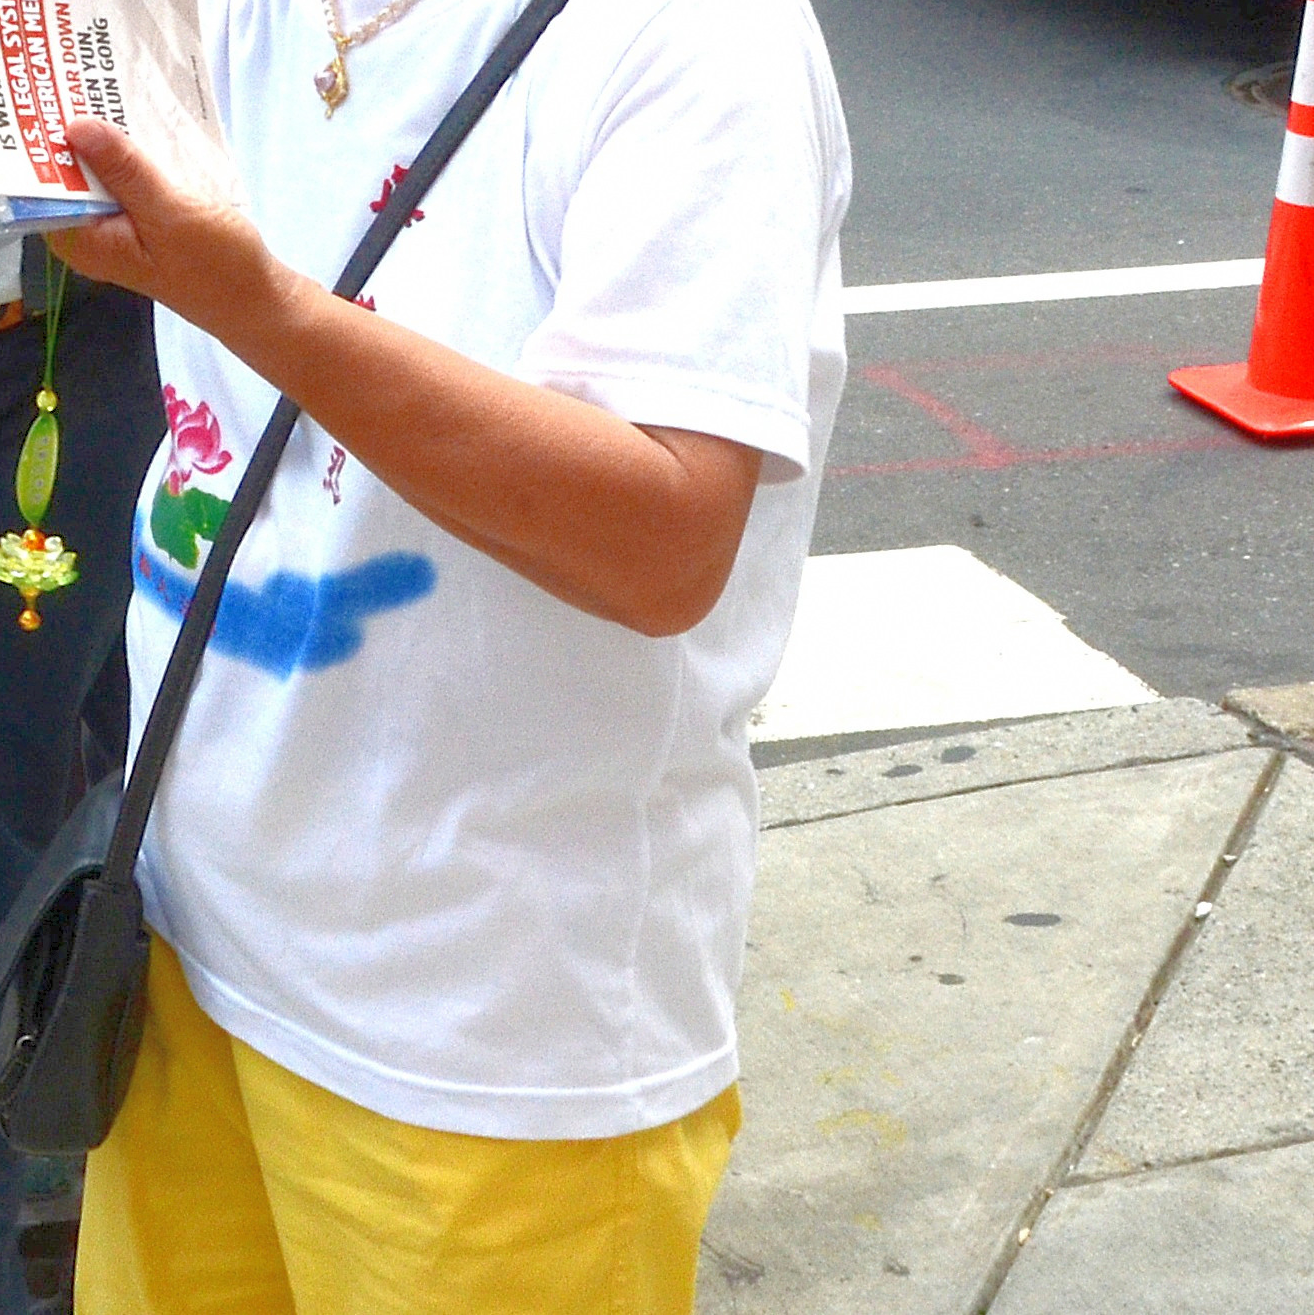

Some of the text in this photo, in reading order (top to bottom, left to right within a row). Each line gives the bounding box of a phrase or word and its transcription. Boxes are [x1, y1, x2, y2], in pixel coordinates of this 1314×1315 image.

[6, 52, 37, 116] LEGAL
[26, 37, 68, 145] AMERICAN
[55, 2, 88, 115] TEAR DOWN
[77, 25, 108, 121] HEN YUN,
[93, 17, 129, 136] ALUN GONG
[0, 134, 17, 150] IS
[23, 120, 50, 163] U.S.
[54, 150, 74, 166] &
